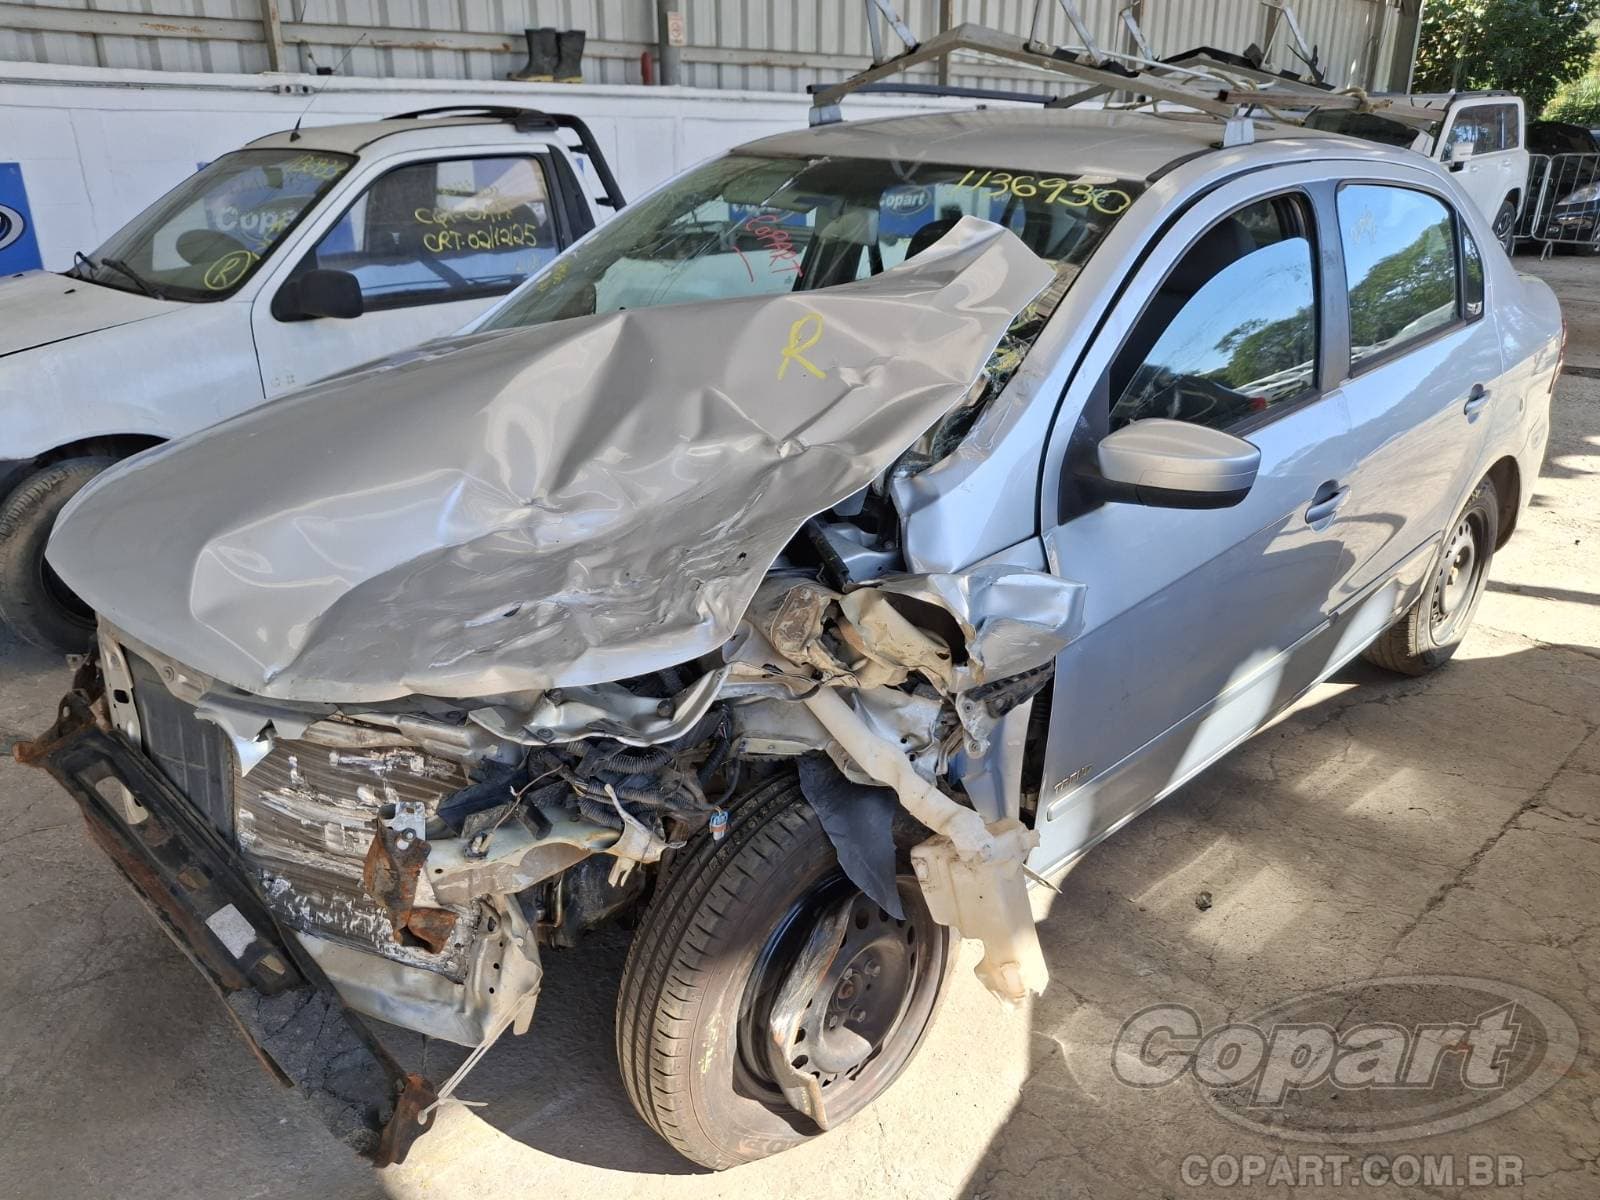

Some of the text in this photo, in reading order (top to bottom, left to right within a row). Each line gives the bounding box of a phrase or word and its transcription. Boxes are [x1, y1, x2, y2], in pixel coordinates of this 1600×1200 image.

[954, 169, 1131, 214] 1136930
[211, 256, 242, 288] R
[777, 312, 827, 382] R
